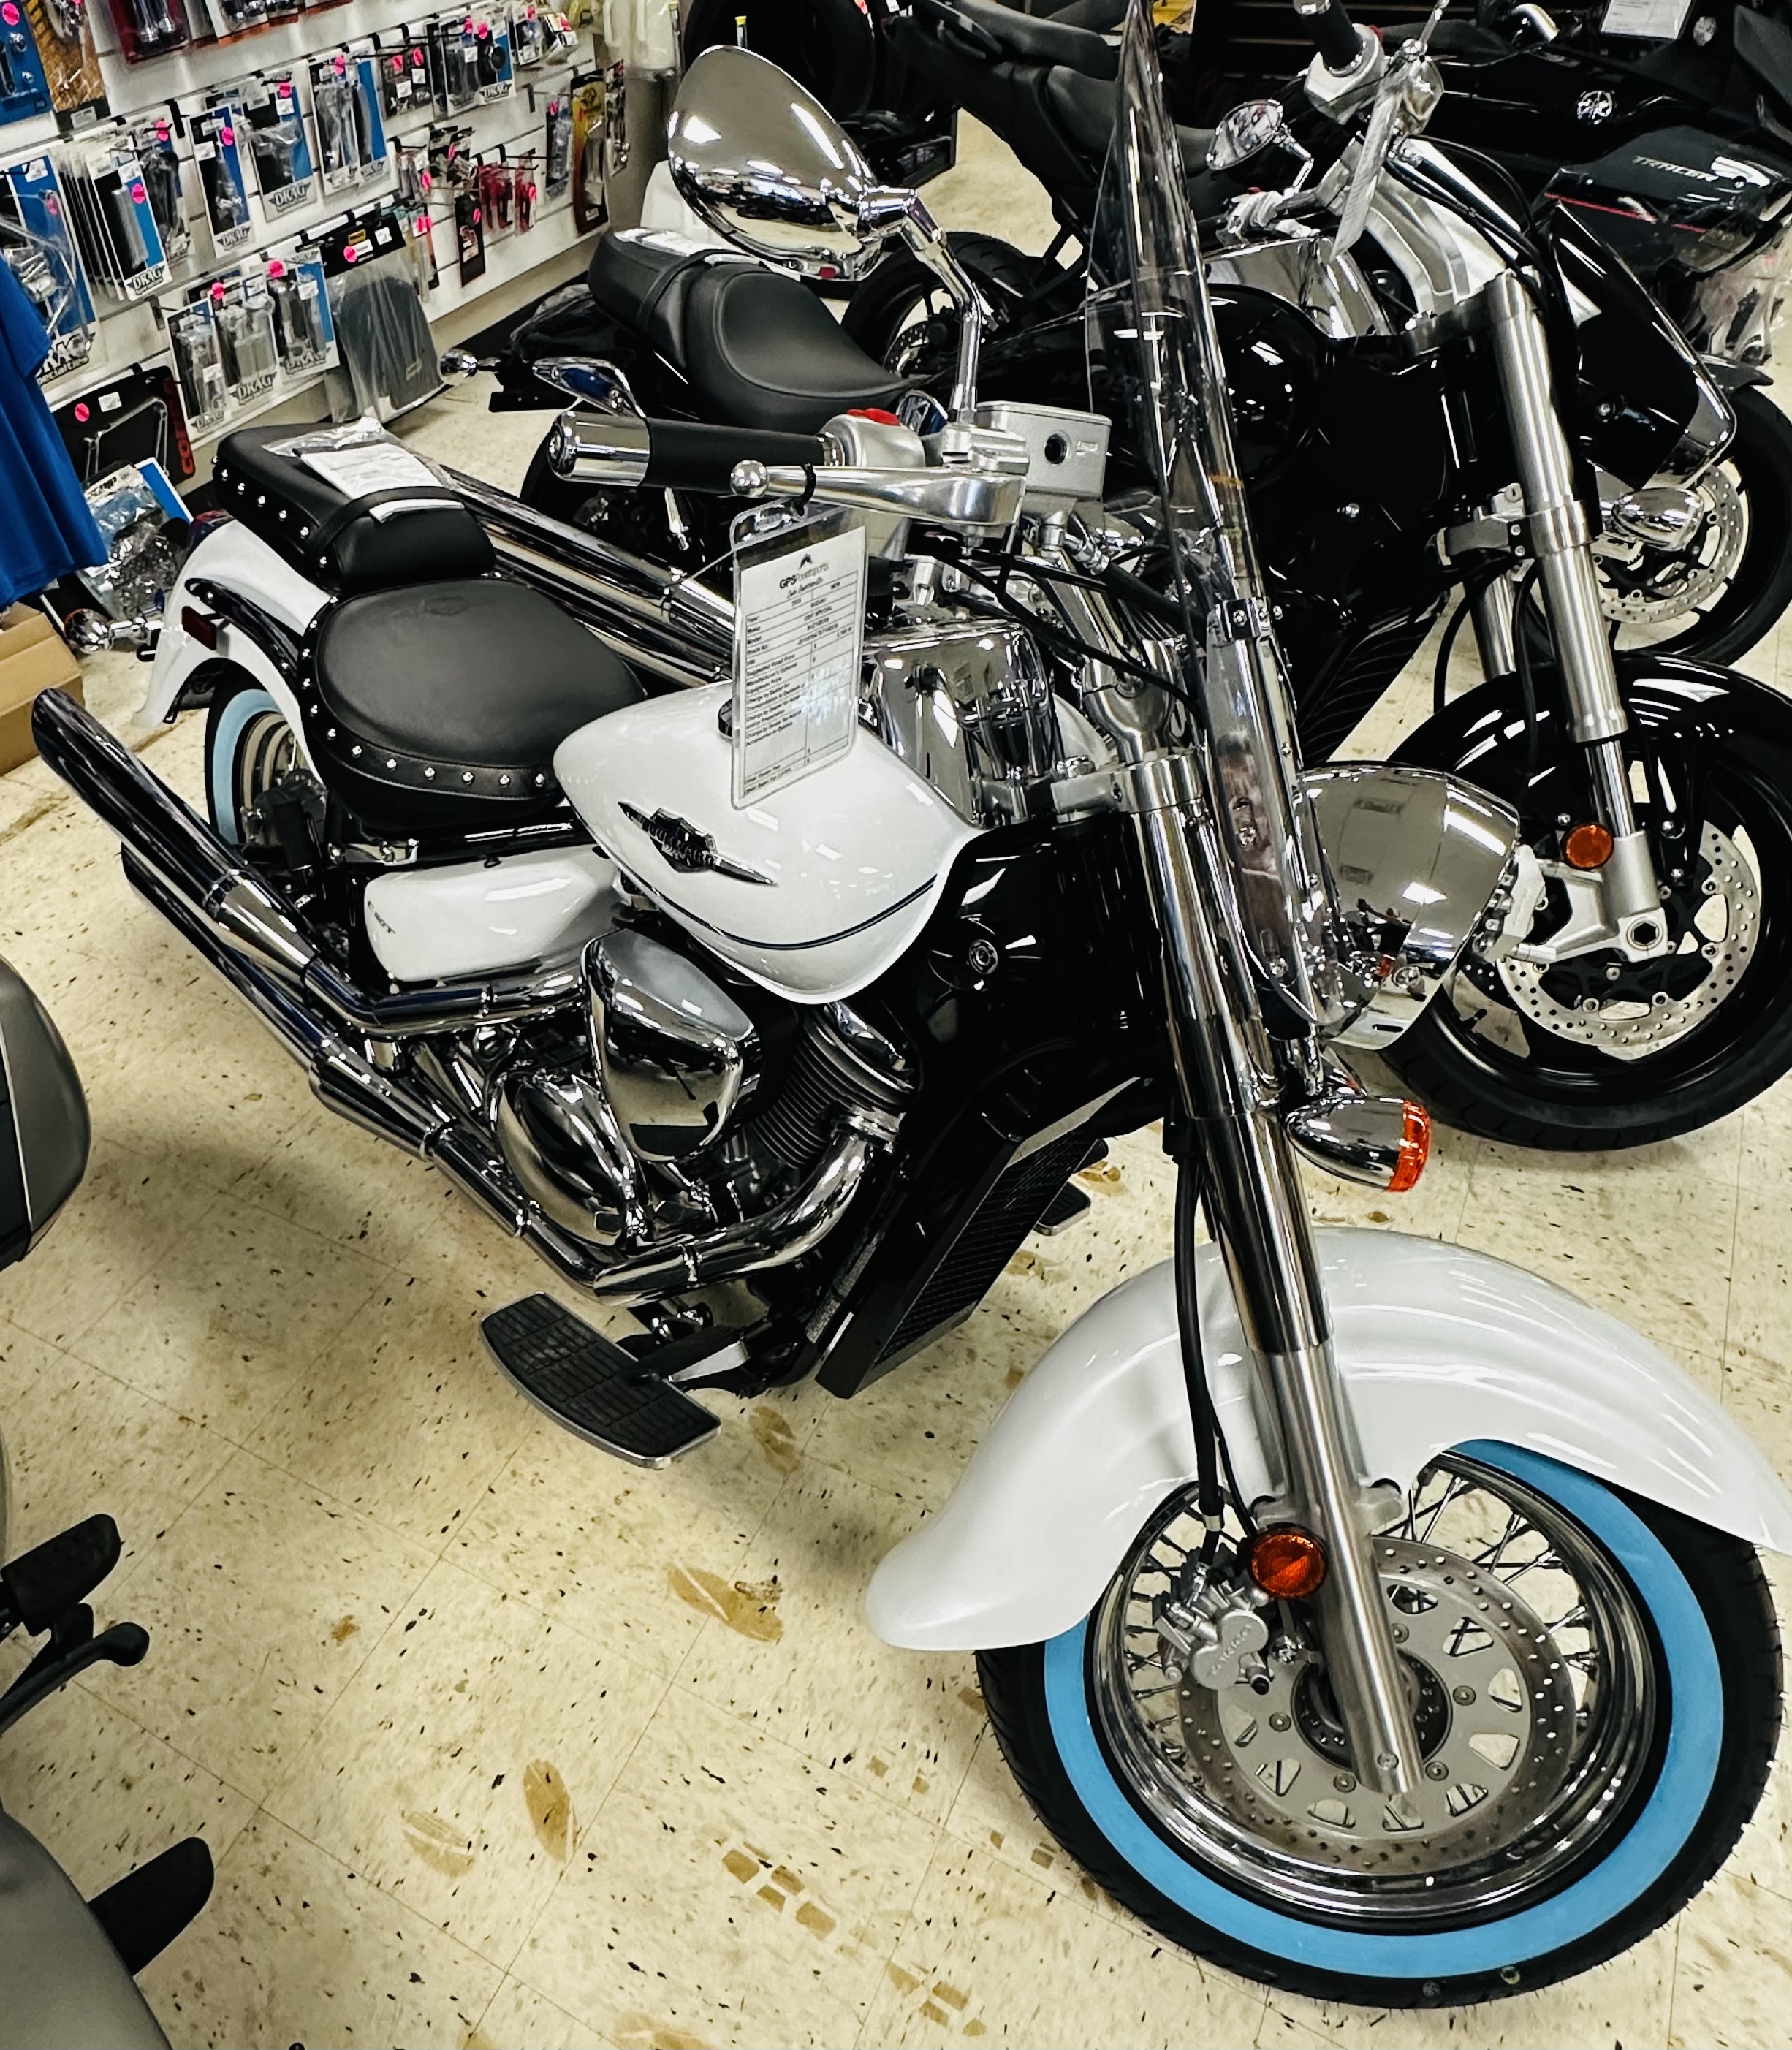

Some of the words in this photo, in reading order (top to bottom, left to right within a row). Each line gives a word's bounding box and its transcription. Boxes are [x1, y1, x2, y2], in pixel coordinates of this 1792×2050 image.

[273, 182, 306, 208] DRAG
[221, 226, 249, 246] DRAG
[132, 265, 163, 290] DRAG
[238, 373, 274, 400] DRAG
